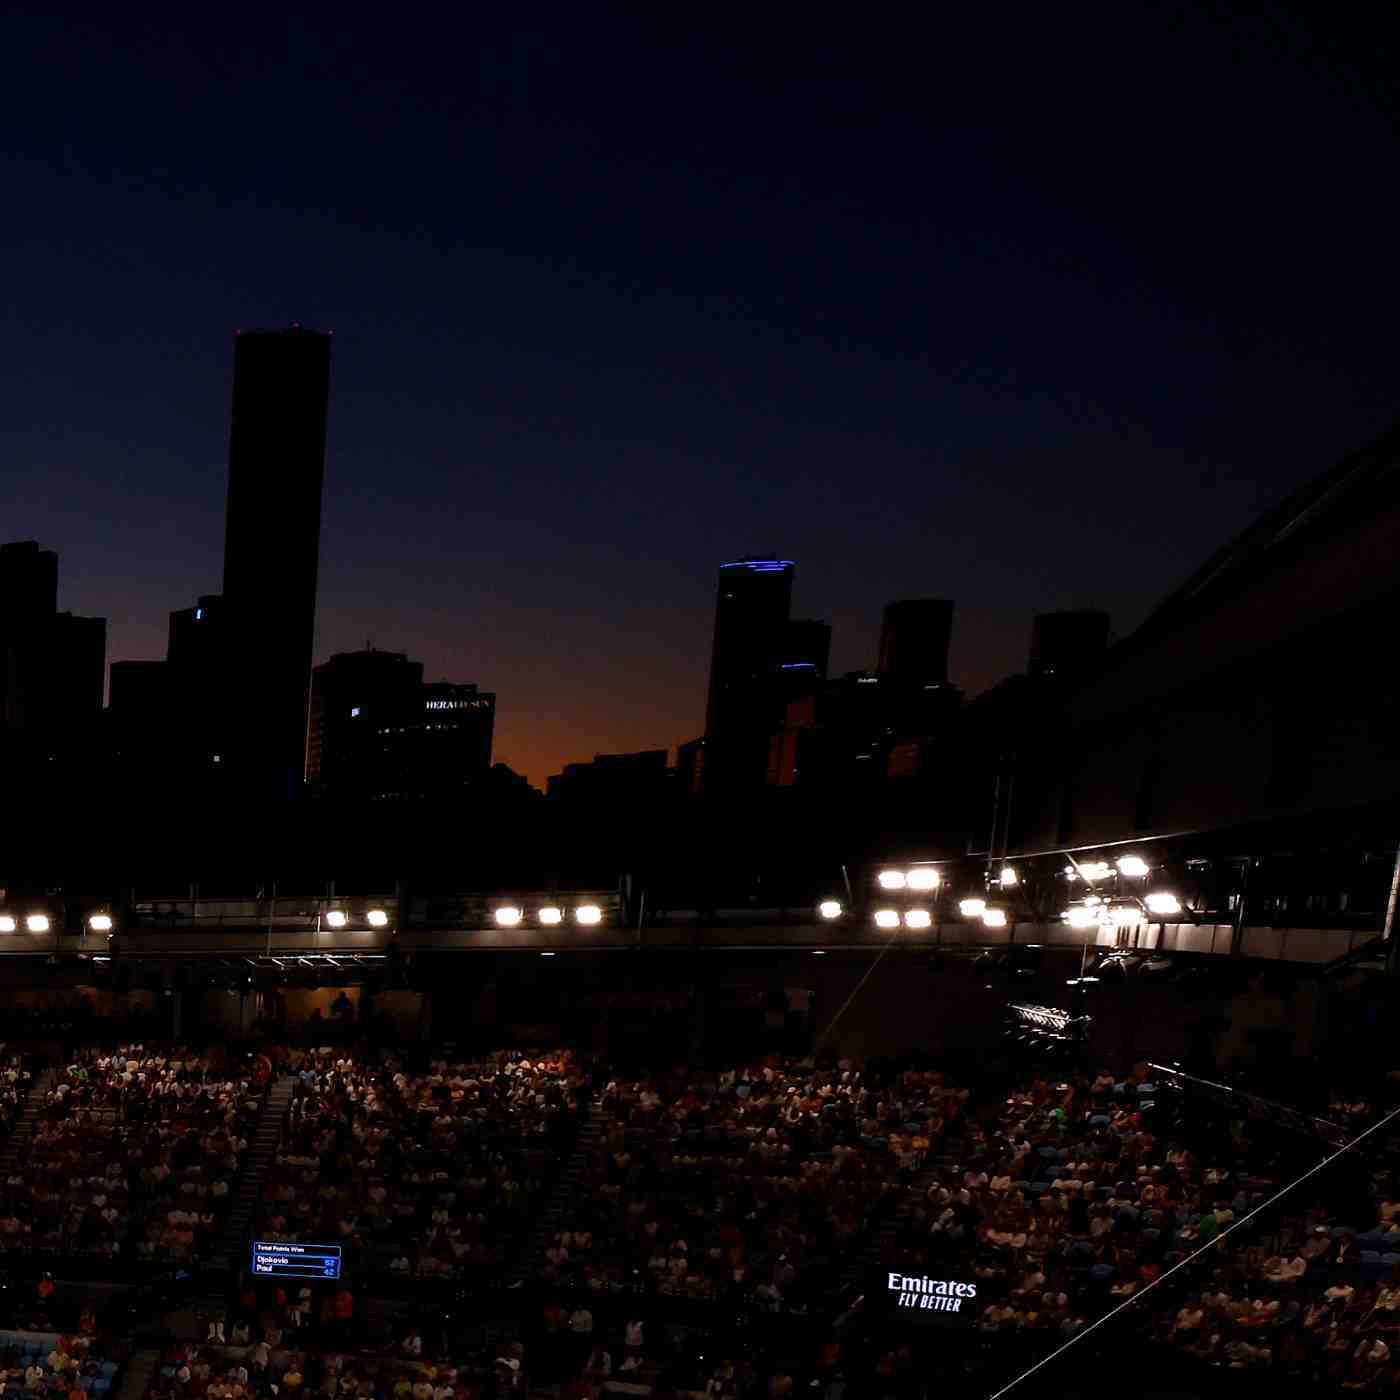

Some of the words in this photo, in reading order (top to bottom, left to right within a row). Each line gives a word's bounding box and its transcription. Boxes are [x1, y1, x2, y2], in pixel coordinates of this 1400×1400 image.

[888, 1272, 976, 1297] Emirates
[899, 1293, 918, 1307] FLY
[920, 1294, 961, 1312] BETTER
